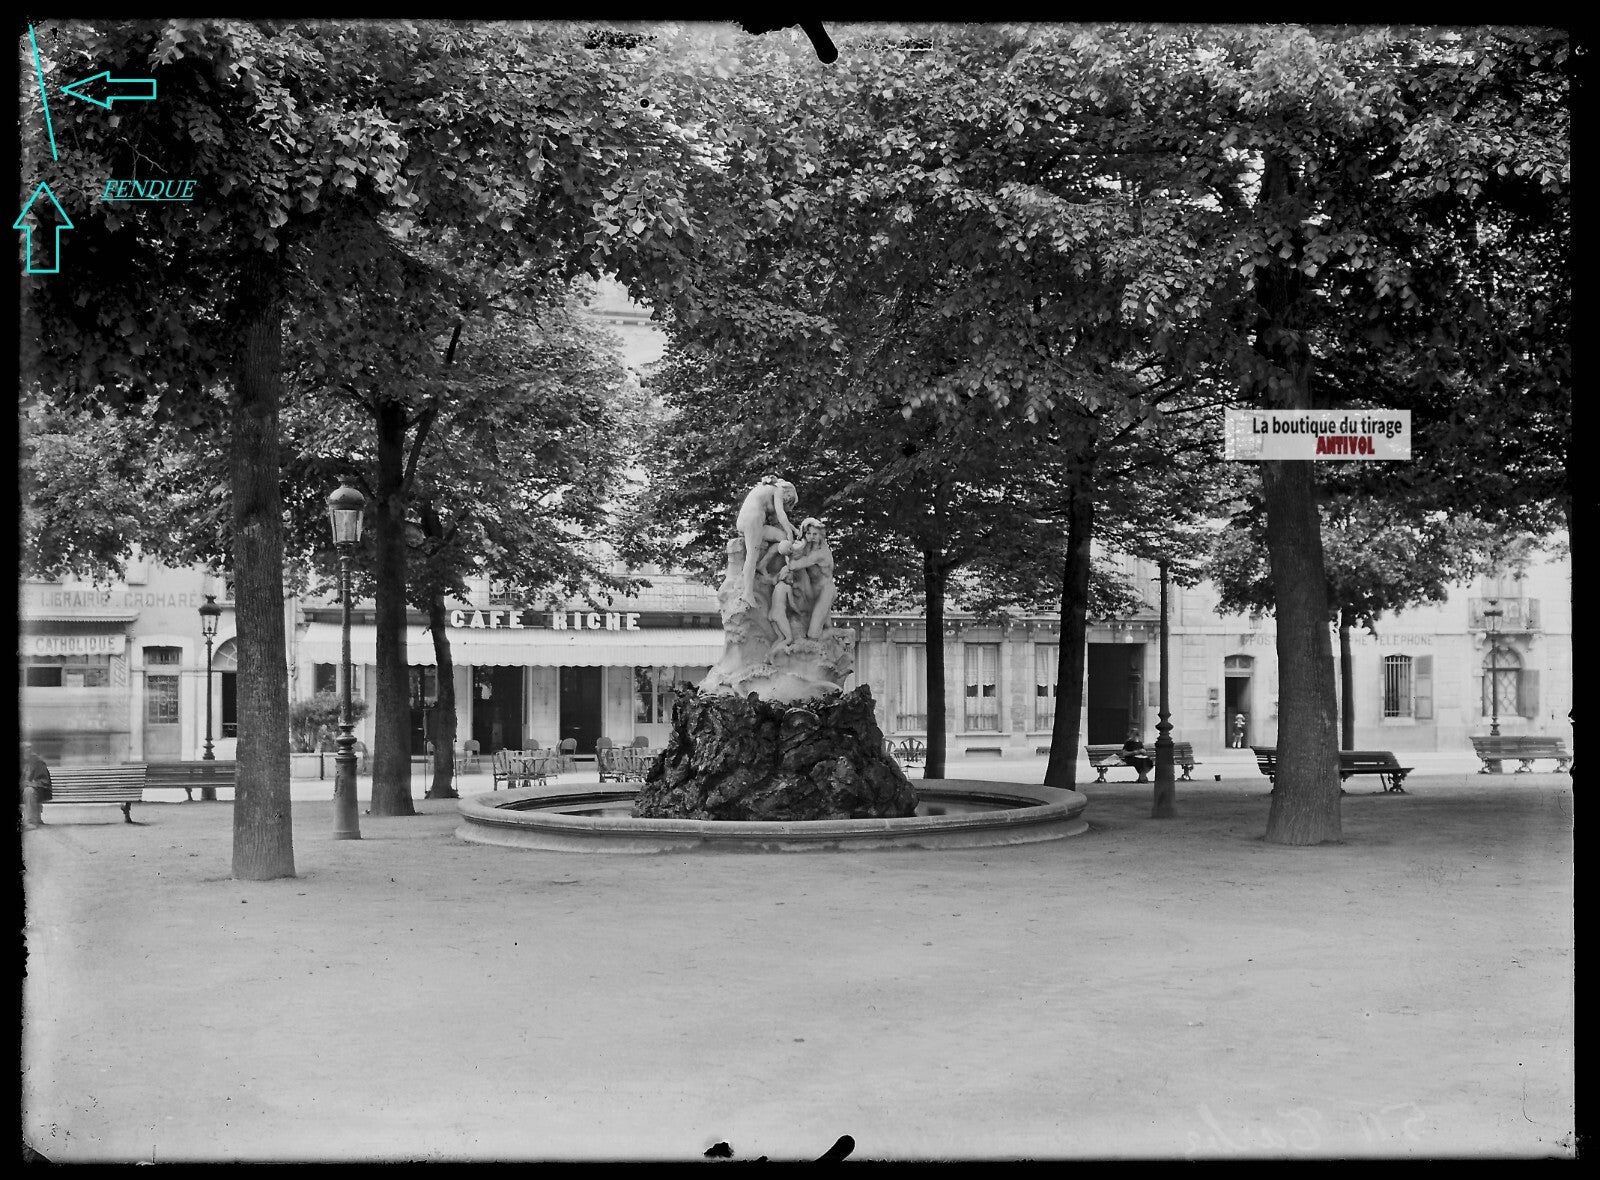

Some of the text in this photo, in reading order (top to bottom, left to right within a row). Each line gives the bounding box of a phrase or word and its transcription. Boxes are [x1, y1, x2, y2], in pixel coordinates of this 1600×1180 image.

[450, 610, 641, 631] CAFE RICHE
[35, 636, 115, 652] CATHOLIQUE
